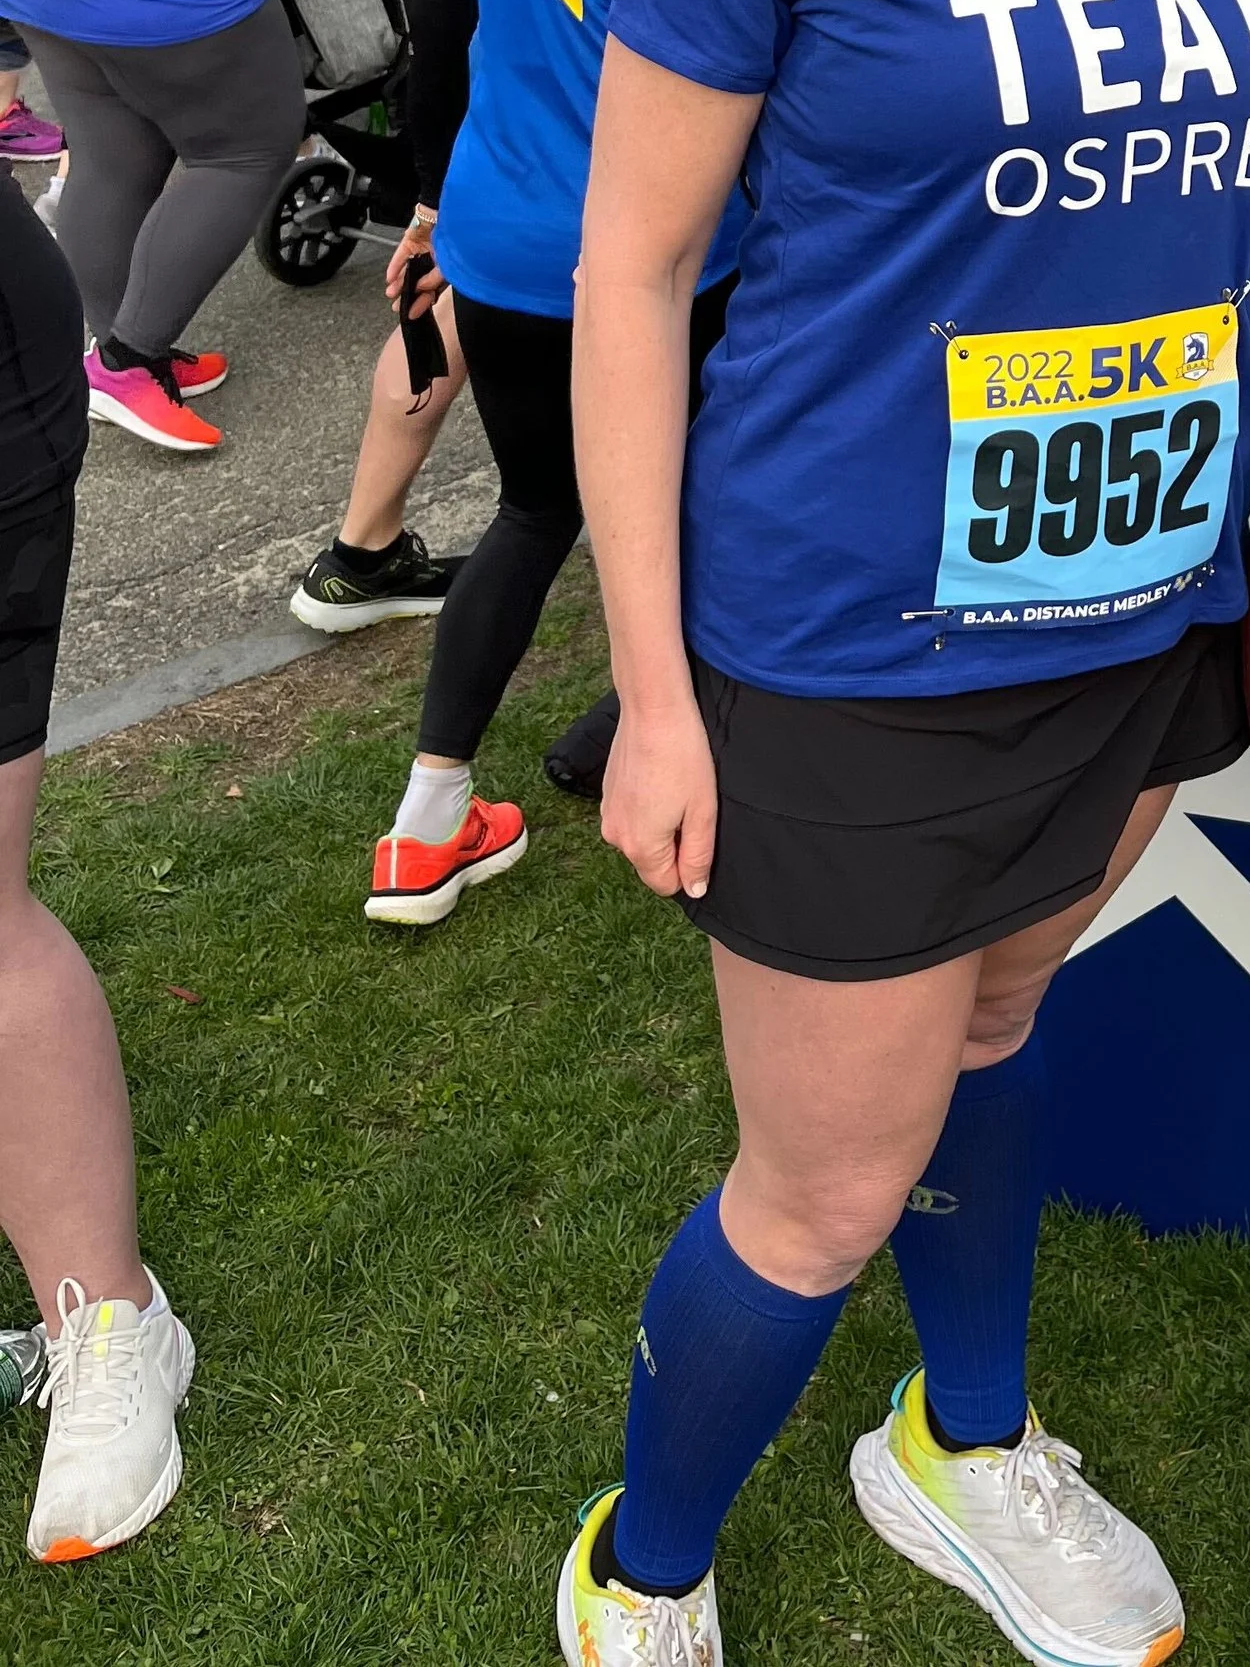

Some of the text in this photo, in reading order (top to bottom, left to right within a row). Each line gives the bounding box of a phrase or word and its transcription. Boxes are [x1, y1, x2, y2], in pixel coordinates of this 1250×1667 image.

[984, 350, 1073, 384] 2022
[986, 337, 1168, 410] B.A.A. 5K
[968, 400, 1221, 563] 9952
[963, 583, 1172, 625] B.A.A. DISTANCE MEDLEY
